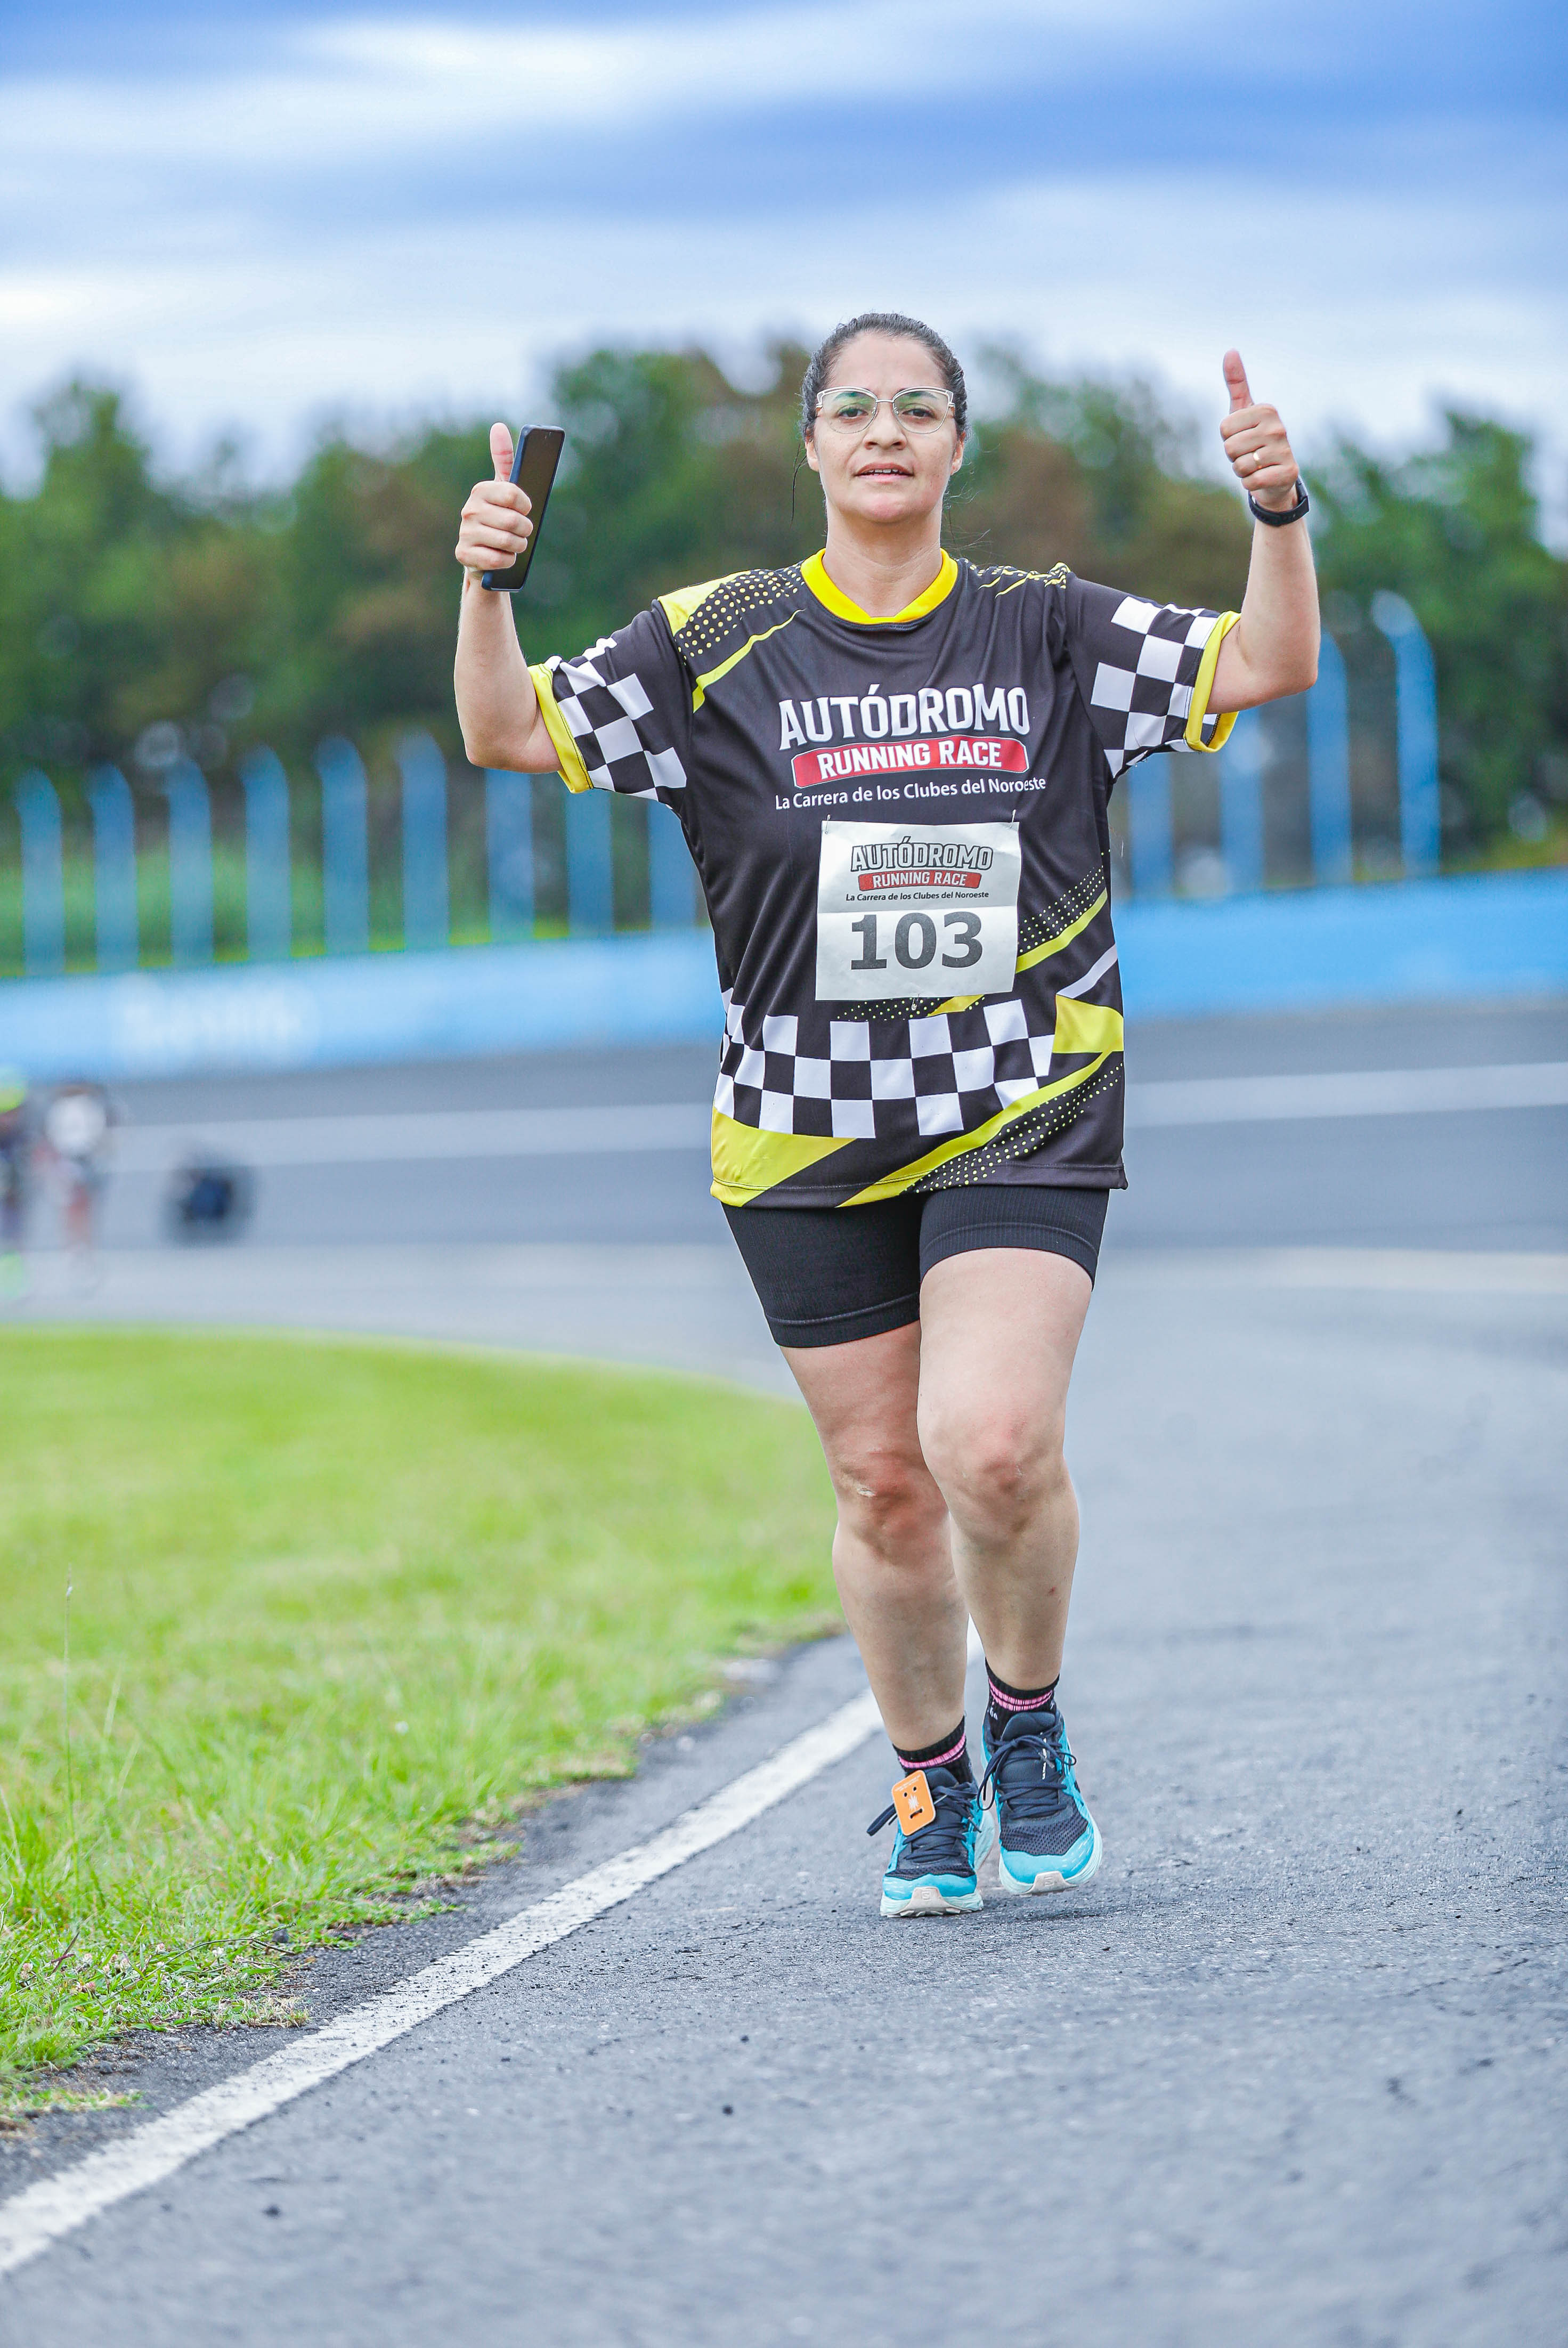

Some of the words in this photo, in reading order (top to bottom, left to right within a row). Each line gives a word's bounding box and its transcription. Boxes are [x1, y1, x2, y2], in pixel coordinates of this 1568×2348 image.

[778, 683, 1030, 751] AUTÓDROMO
[816, 743, 931, 780] RUNNING
[938, 740, 1002, 767] RACE
[775, 795, 790, 810] La
[793, 791, 848, 808] Carrera
[852, 786, 873, 802] de
[876, 785, 900, 800] los
[903, 782, 958, 799] Clubes
[961, 778, 985, 794] del
[988, 777, 1046, 793] Noroeste
[850, 835, 994, 872] AUTÓDROMO
[872, 871, 930, 888] RUNNING
[933, 872, 968, 886] RACE
[913, 891, 939, 900] Clubes
[851, 911, 983, 970] 103
